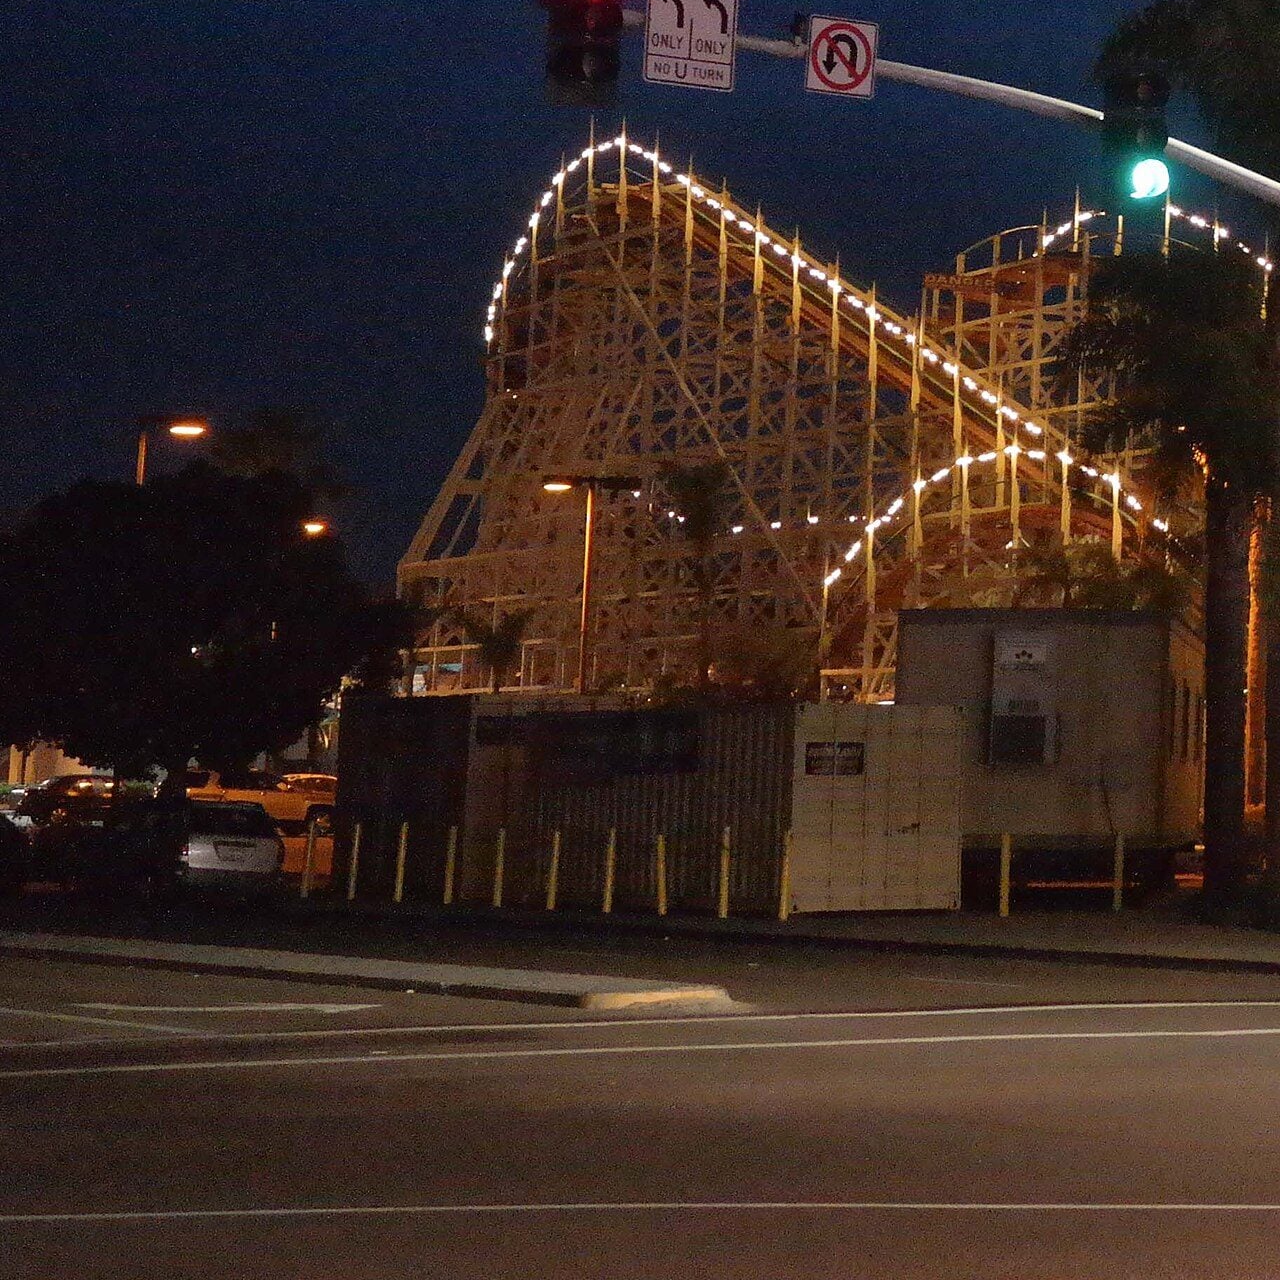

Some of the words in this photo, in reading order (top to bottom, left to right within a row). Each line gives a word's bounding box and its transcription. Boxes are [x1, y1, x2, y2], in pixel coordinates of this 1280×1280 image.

[651, 33, 684, 49] ONLY
[696, 39, 727, 55] ONLY
[654, 62, 671, 75] NO
[675, 62, 688, 79] U
[692, 67, 724, 80] TURN
